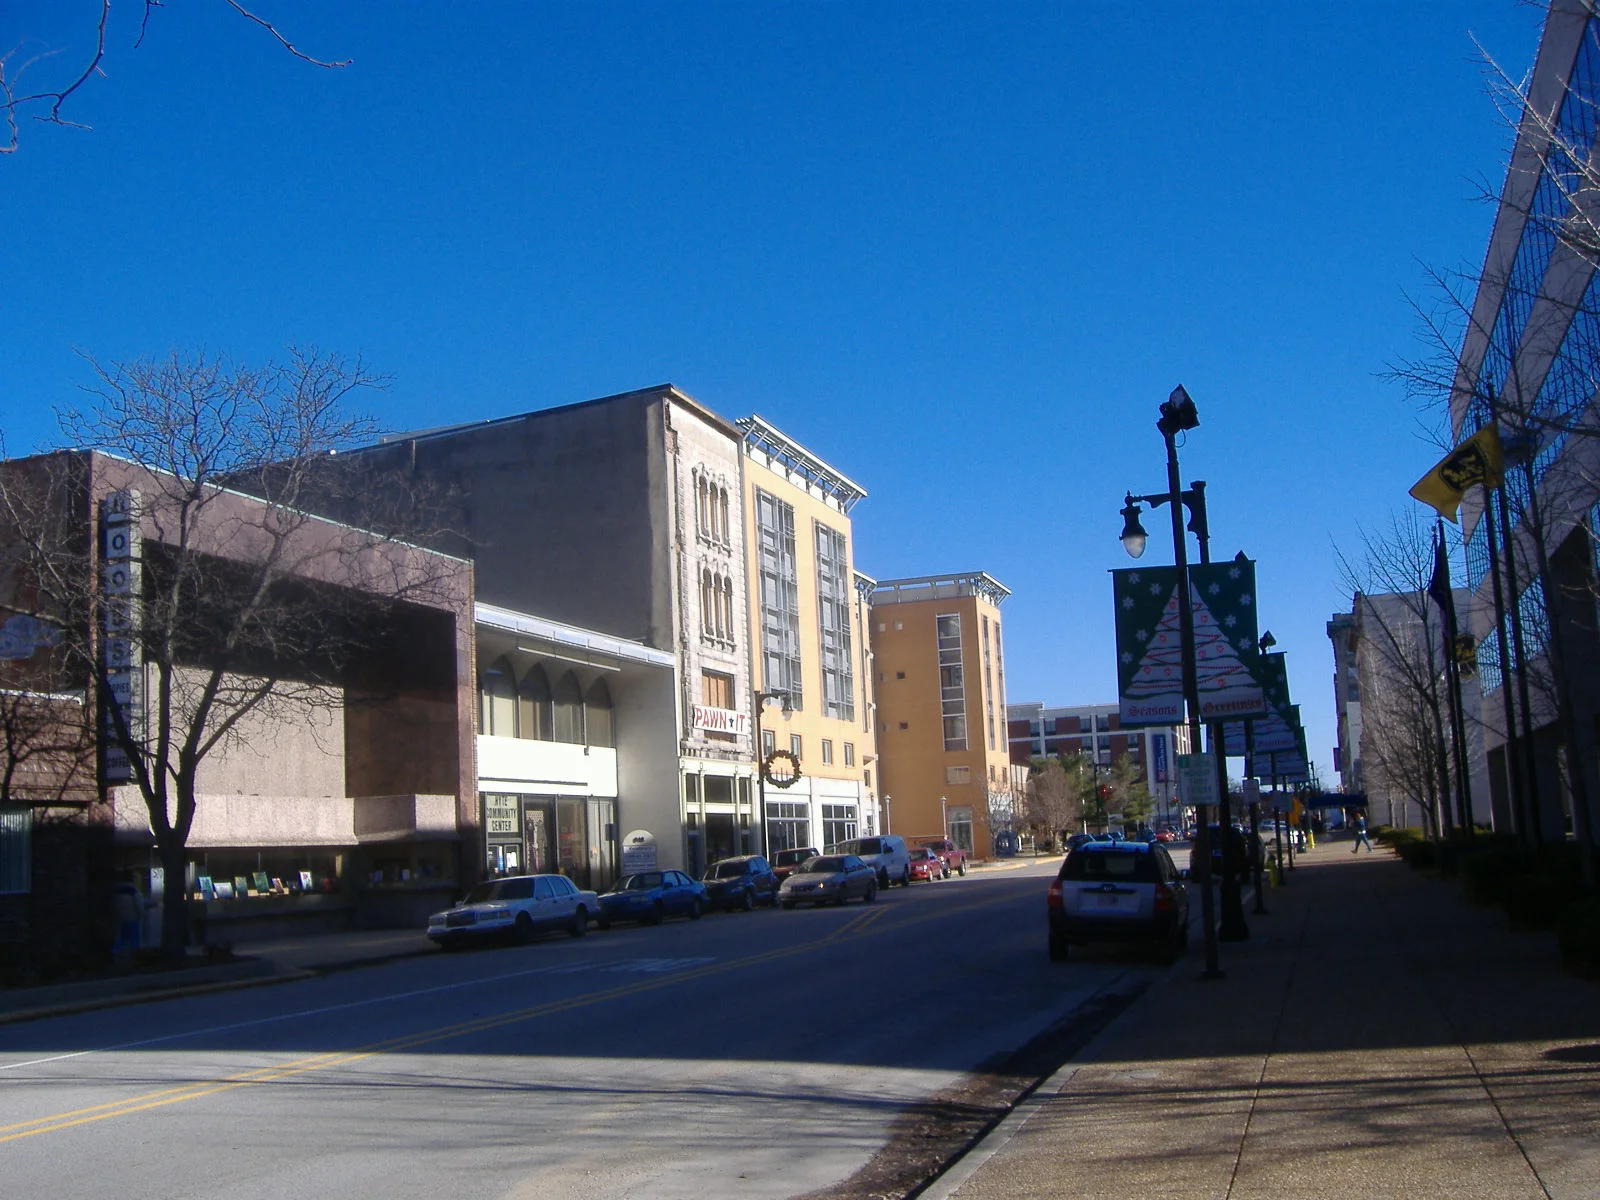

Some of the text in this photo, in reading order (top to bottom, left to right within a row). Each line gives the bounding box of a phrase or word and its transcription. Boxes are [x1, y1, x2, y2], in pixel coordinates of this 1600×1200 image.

[1128, 704, 1177, 717] Seasons
[695, 708, 746, 732] PAWN IT
[486, 808, 517, 819] COMMUNITY
[491, 820, 512, 832] CENTER
